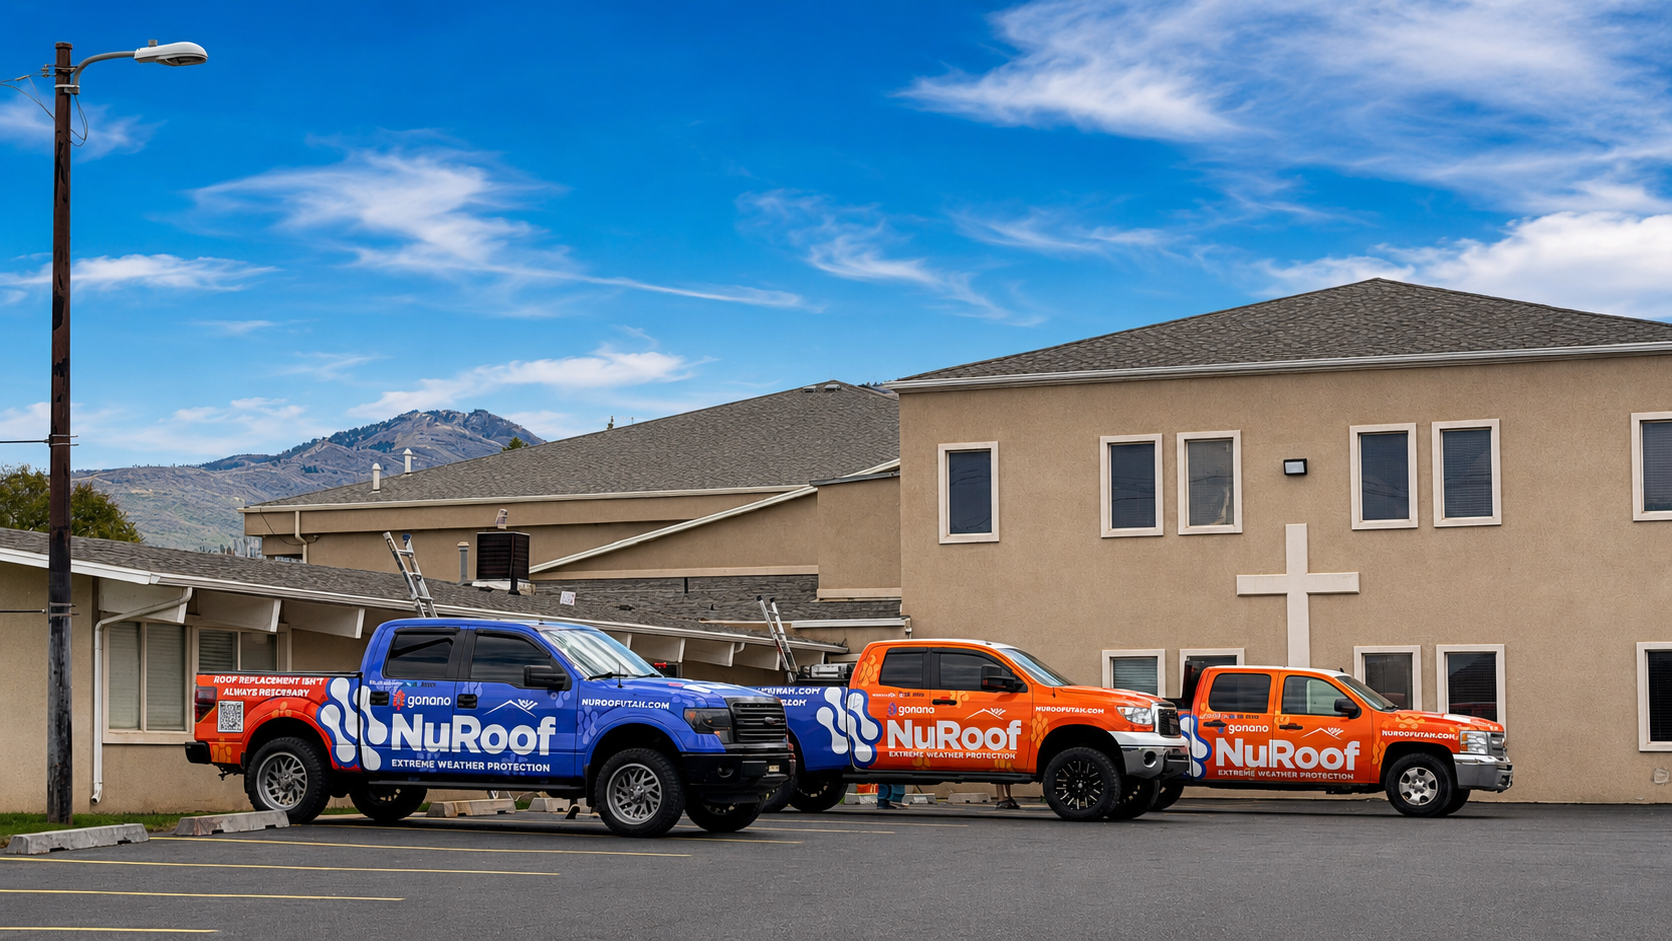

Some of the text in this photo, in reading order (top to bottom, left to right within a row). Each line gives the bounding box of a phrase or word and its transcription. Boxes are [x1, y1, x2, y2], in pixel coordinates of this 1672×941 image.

[223, 688, 257, 697] ALWAYS
[407, 696, 451, 708] gonano
[898, 706, 935, 716] gonano
[391, 713, 556, 756] NuRoof
[887, 719, 1022, 751] NuRoof
[1228, 724, 1269, 735] gonano
[926, 751, 964, 759] WEATHER
[1215, 737, 1361, 771] NuRoof
[391, 759, 550, 773] EXTREME WEATHER PROTECTION
[1218, 769, 1354, 780] EXTREME WEATHER PROTECTION
